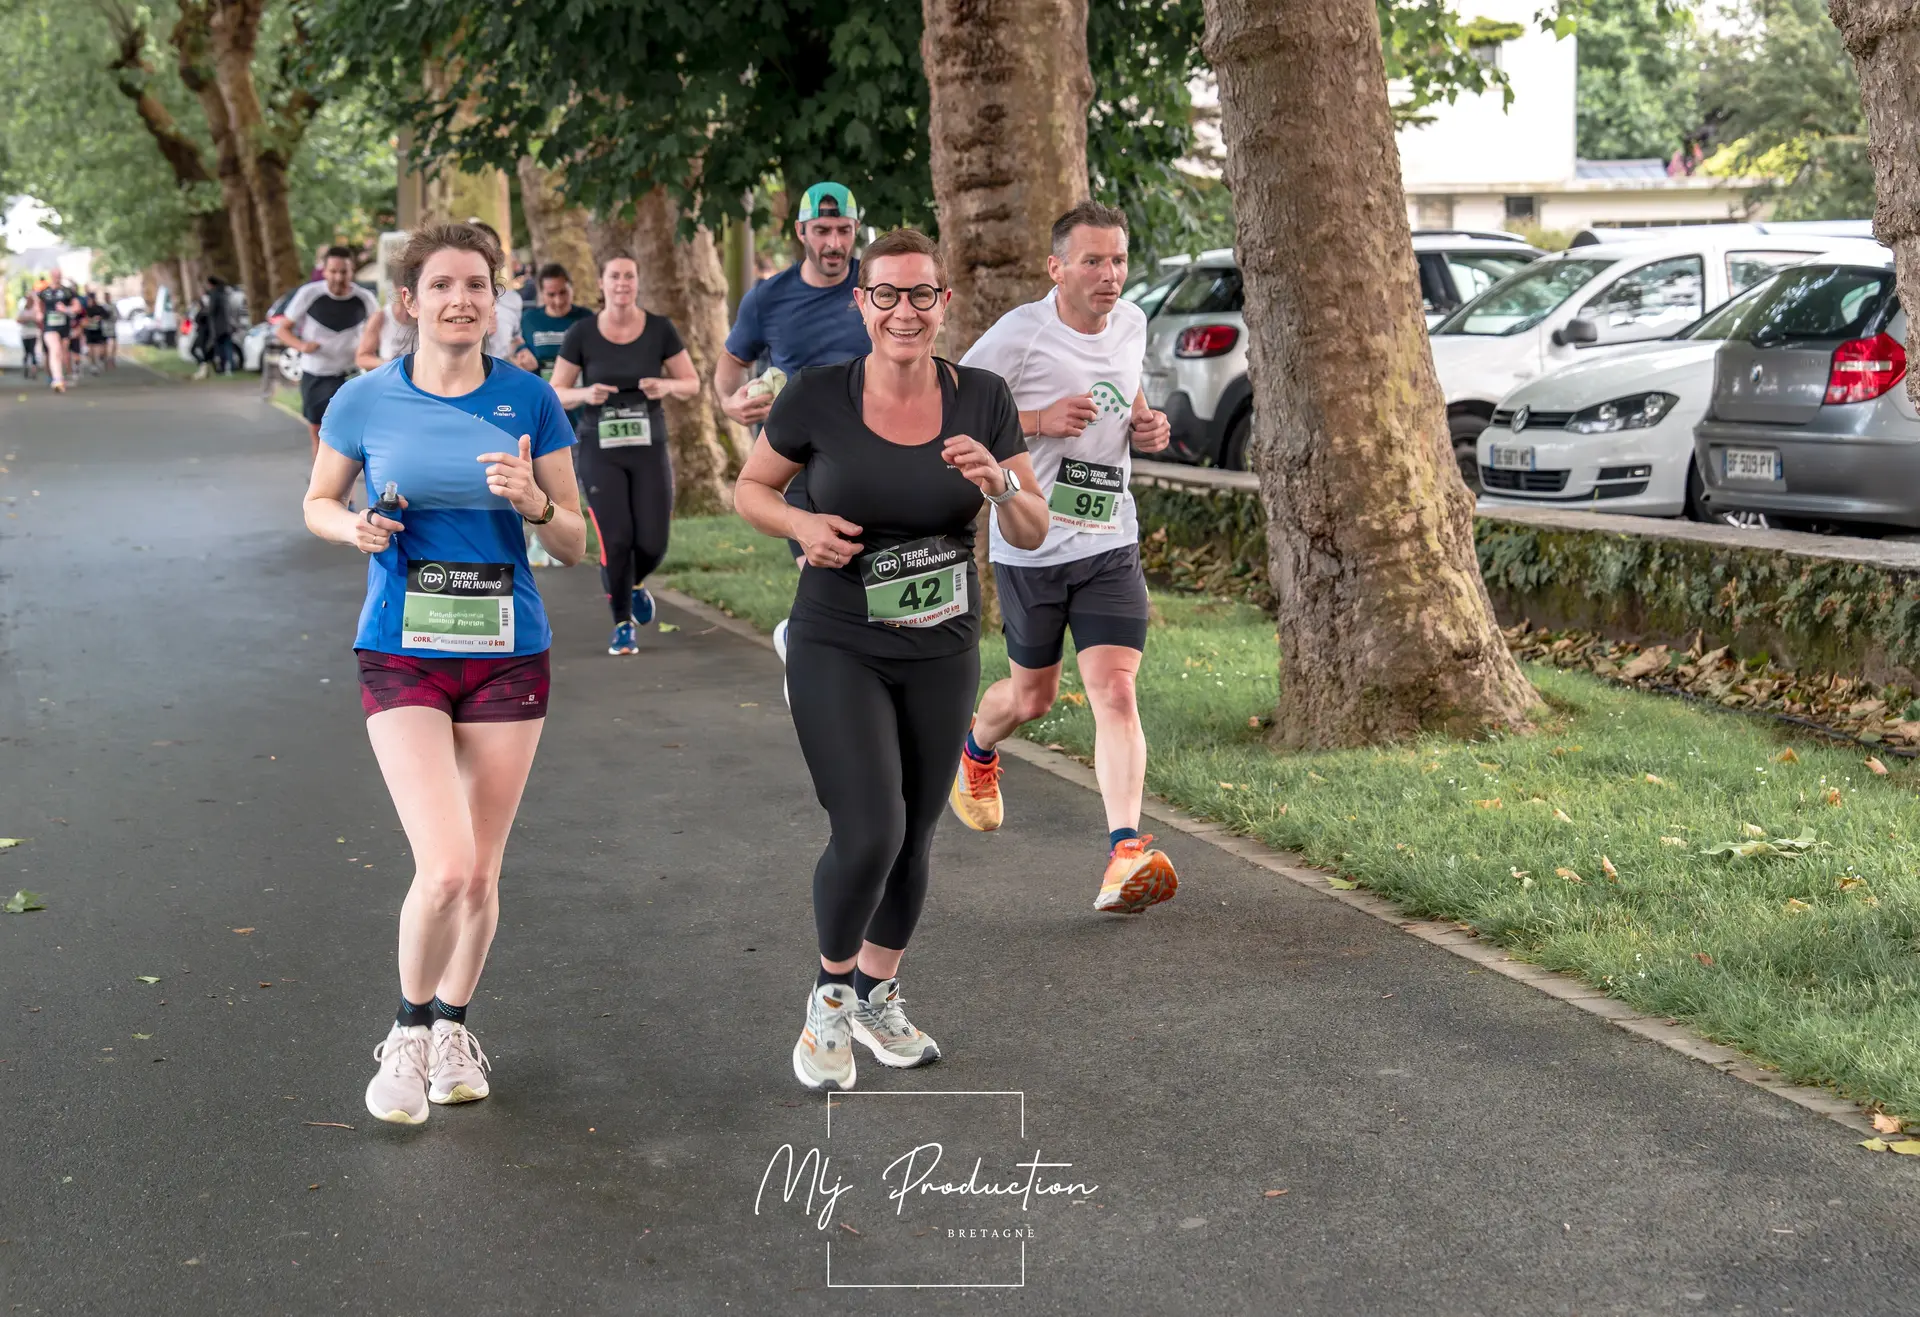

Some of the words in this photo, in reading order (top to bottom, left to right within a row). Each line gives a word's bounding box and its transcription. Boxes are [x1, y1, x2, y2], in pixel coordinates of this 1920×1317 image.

[608, 422, 642, 437] 319
[1070, 469, 1087, 480] TDR
[1090, 469, 1108, 479] TERRE
[1074, 493, 1107, 518] 95
[901, 547, 929, 562] TERRE
[876, 559, 897, 573] TDR
[422, 572, 444, 584] TDR
[449, 570, 479, 581] TERRE
[898, 577, 942, 611] 42
[909, 617, 918, 625] DE
